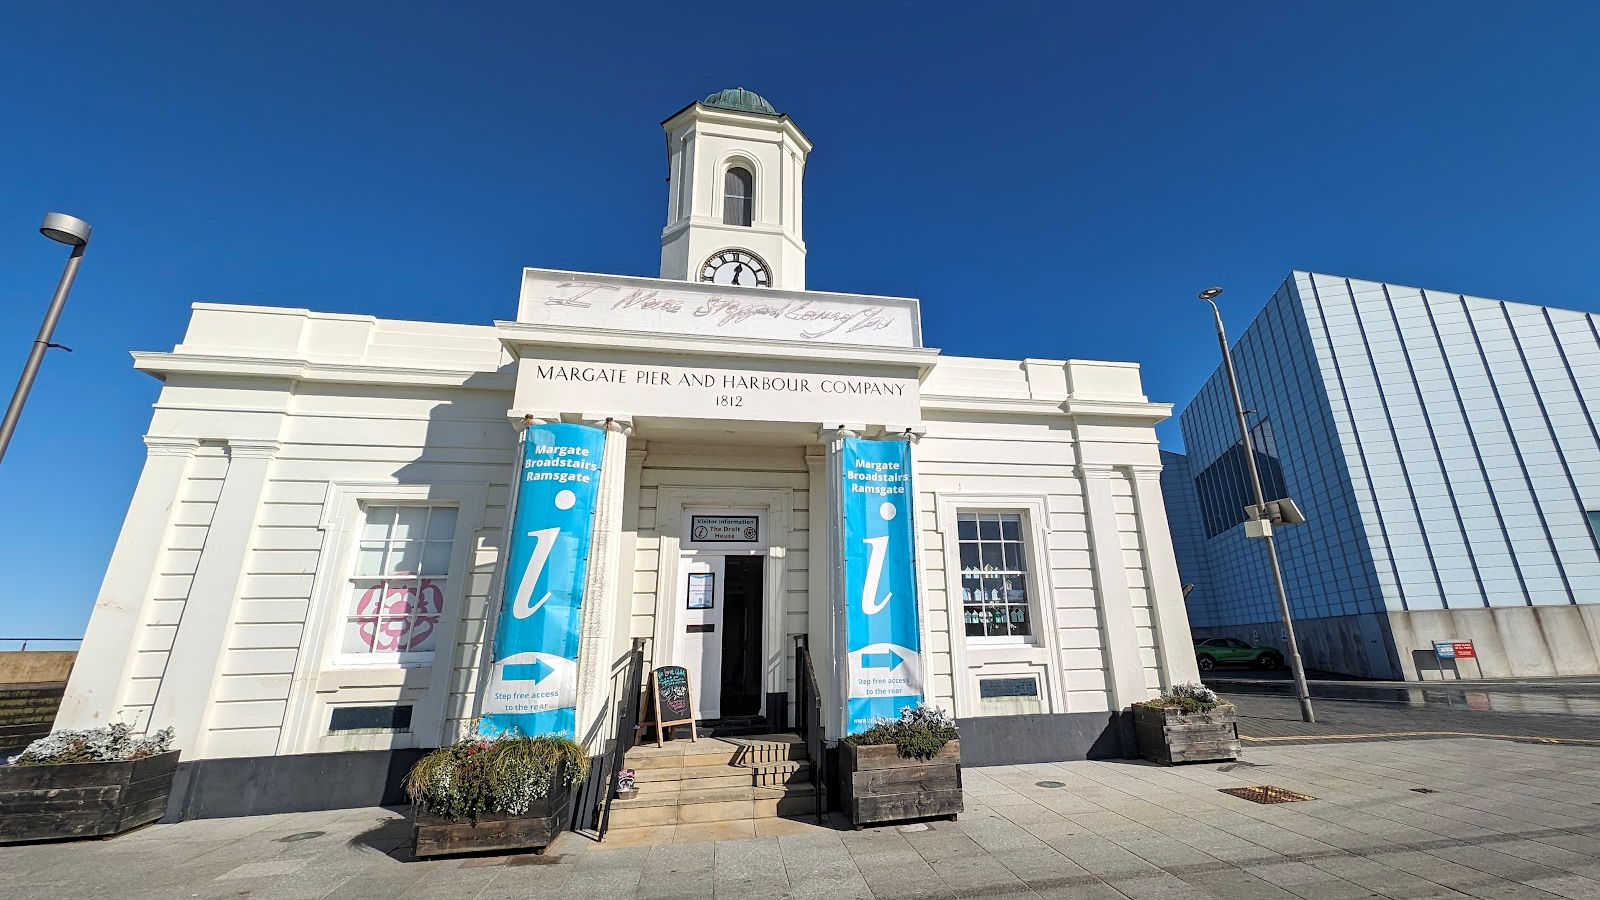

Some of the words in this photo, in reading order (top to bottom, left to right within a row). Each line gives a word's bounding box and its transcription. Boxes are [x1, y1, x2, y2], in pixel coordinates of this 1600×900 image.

[536, 365, 628, 384] MARGATE
[636, 370, 672, 386] PIER
[678, 373, 715, 388] AND
[723, 375, 812, 392] HARBOUR
[820, 379, 905, 396] COMPANY
[715, 395, 744, 407] 1812
[535, 445, 590, 457] Margate
[525, 457, 598, 471] Broadstairs
[855, 459, 900, 472] Margate
[526, 471, 591, 483] Ramsgate
[847, 470, 909, 482] Broadstairs
[851, 483, 905, 496] Ramsgate
[495, 692, 512, 701] Step
[513, 691, 530, 700] free
[531, 689, 559, 699] access
[866, 688, 873, 696] to
[875, 687, 887, 695] the
[514, 703, 528, 711] the
[530, 703, 547, 711] rear
